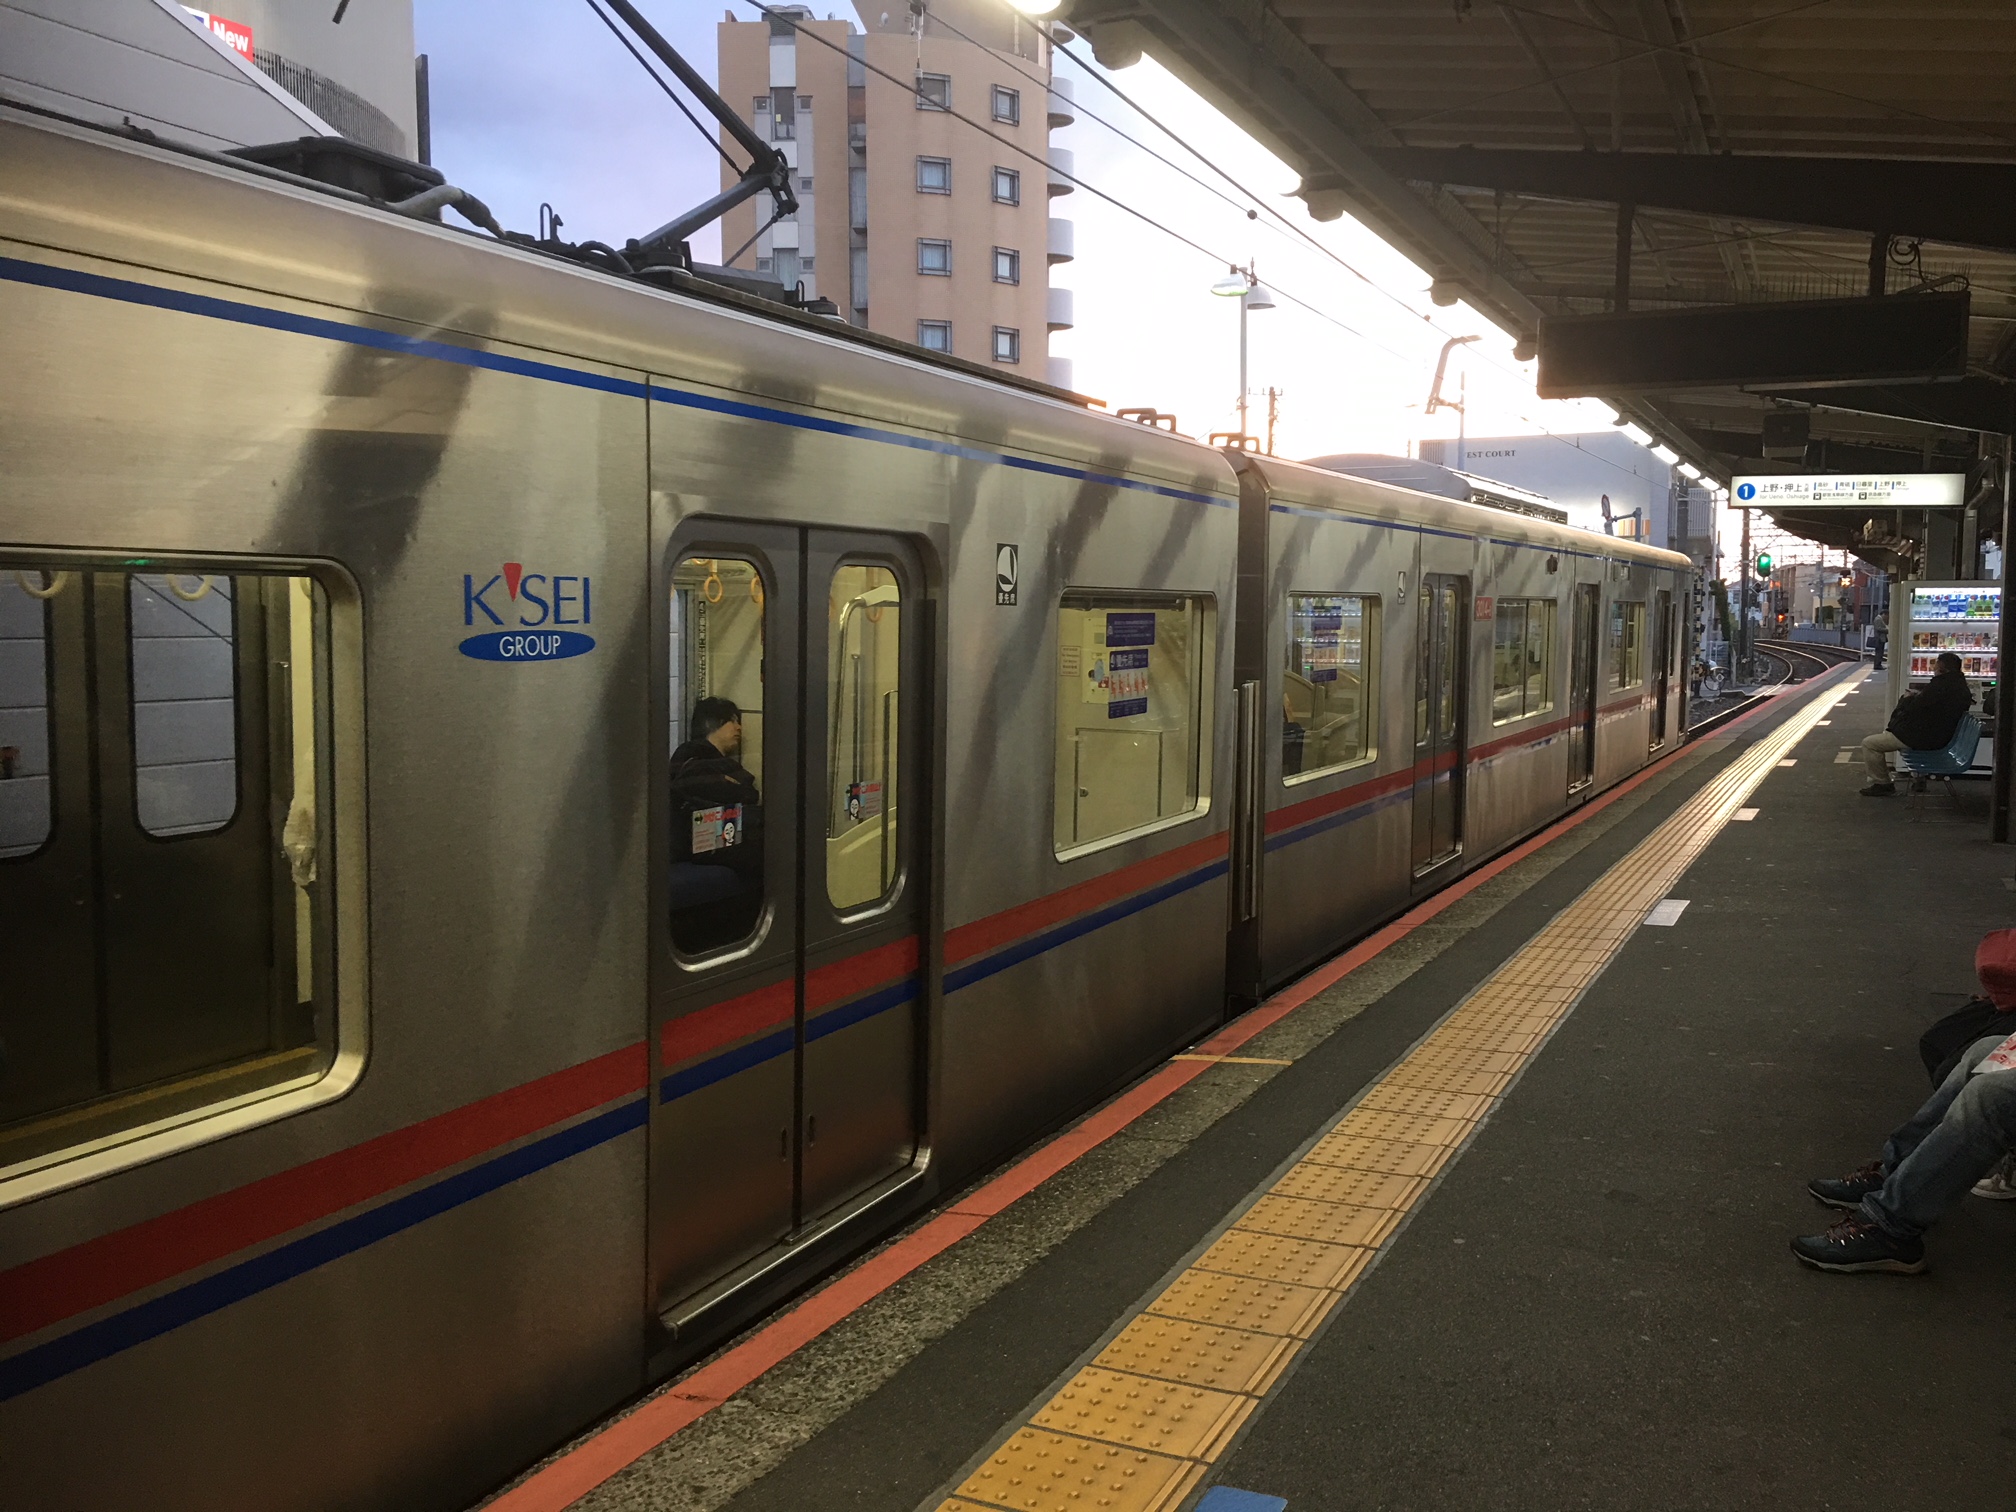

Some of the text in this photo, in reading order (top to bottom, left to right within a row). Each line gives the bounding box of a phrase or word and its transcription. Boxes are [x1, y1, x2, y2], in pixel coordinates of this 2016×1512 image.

[213, 20, 249, 52] New
[1743, 485, 1749, 498] 1
[499, 635, 562, 658] GROUP
